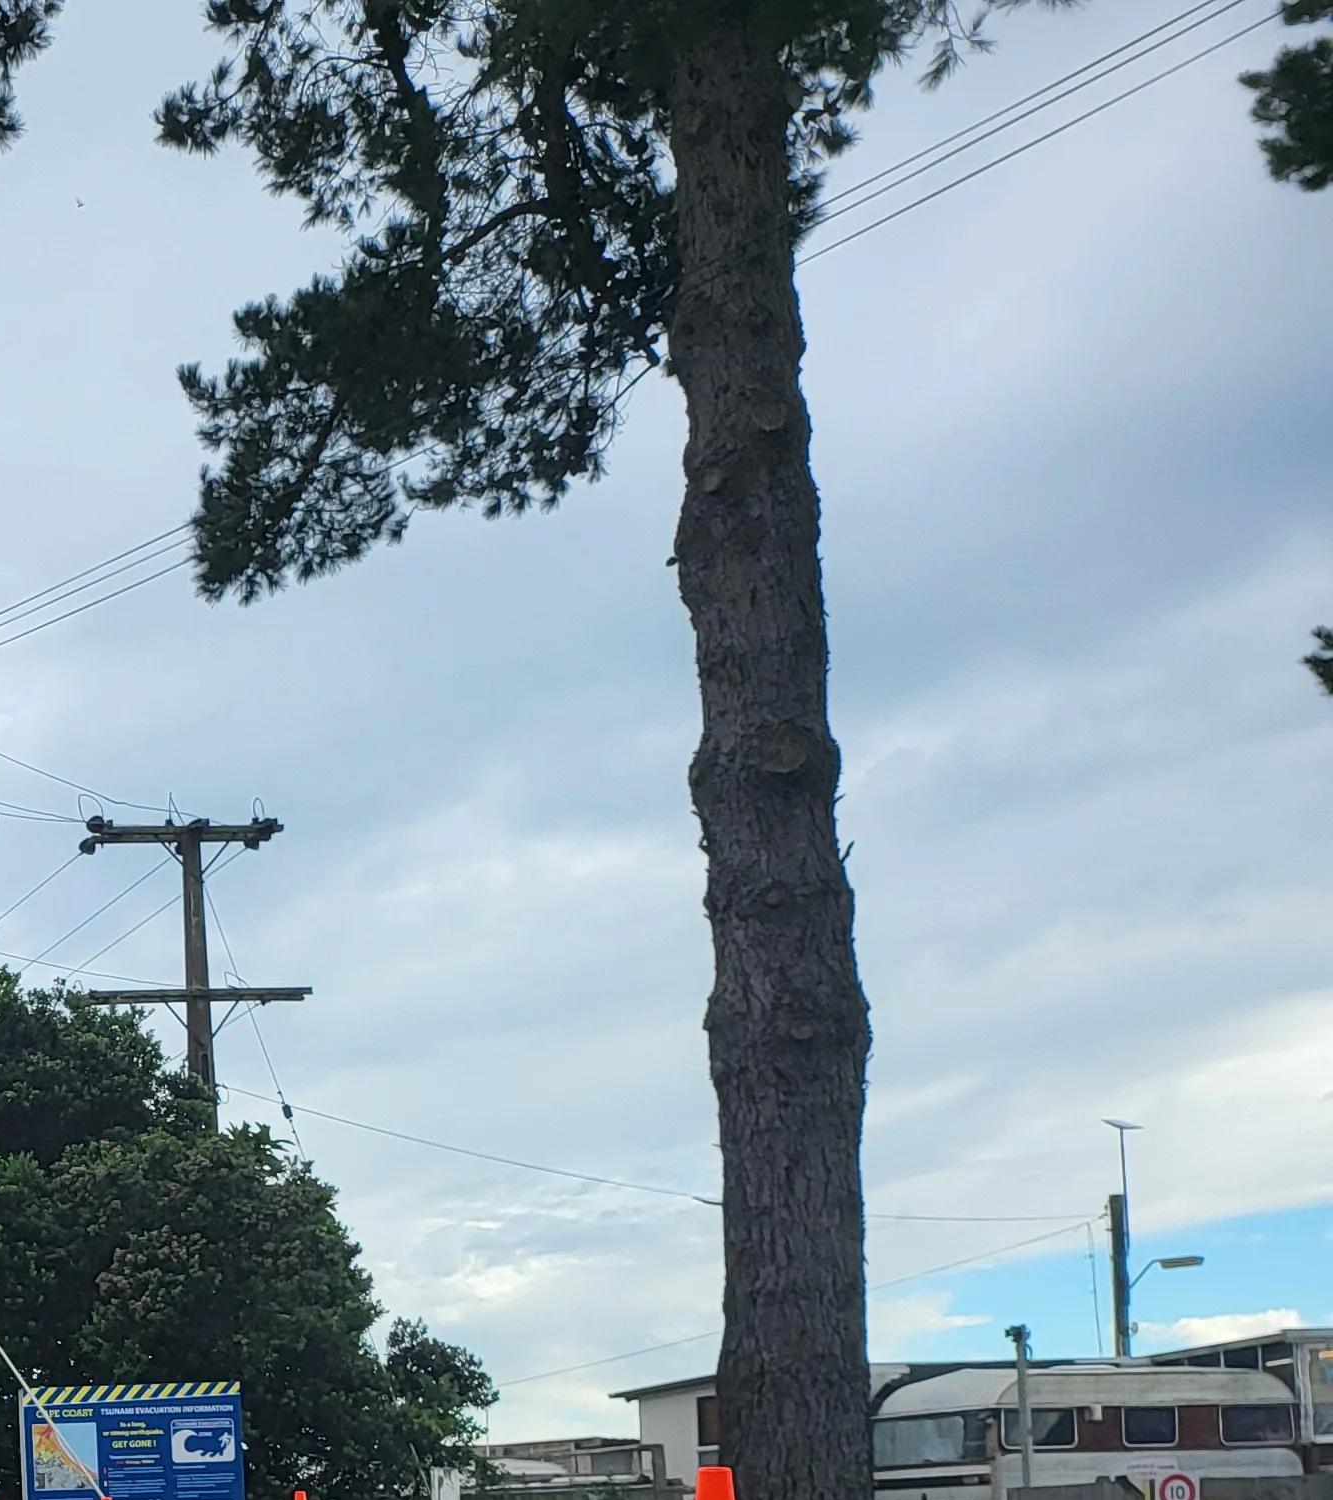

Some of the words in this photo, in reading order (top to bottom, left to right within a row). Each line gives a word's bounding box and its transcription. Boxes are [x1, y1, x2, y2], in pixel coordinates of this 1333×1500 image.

[62, 1408, 93, 1417] COAST
[135, 1406, 181, 1414] EVACUATION
[182, 1405, 233, 1413] INFORMATION
[1170, 1486, 1185, 1500] 10
